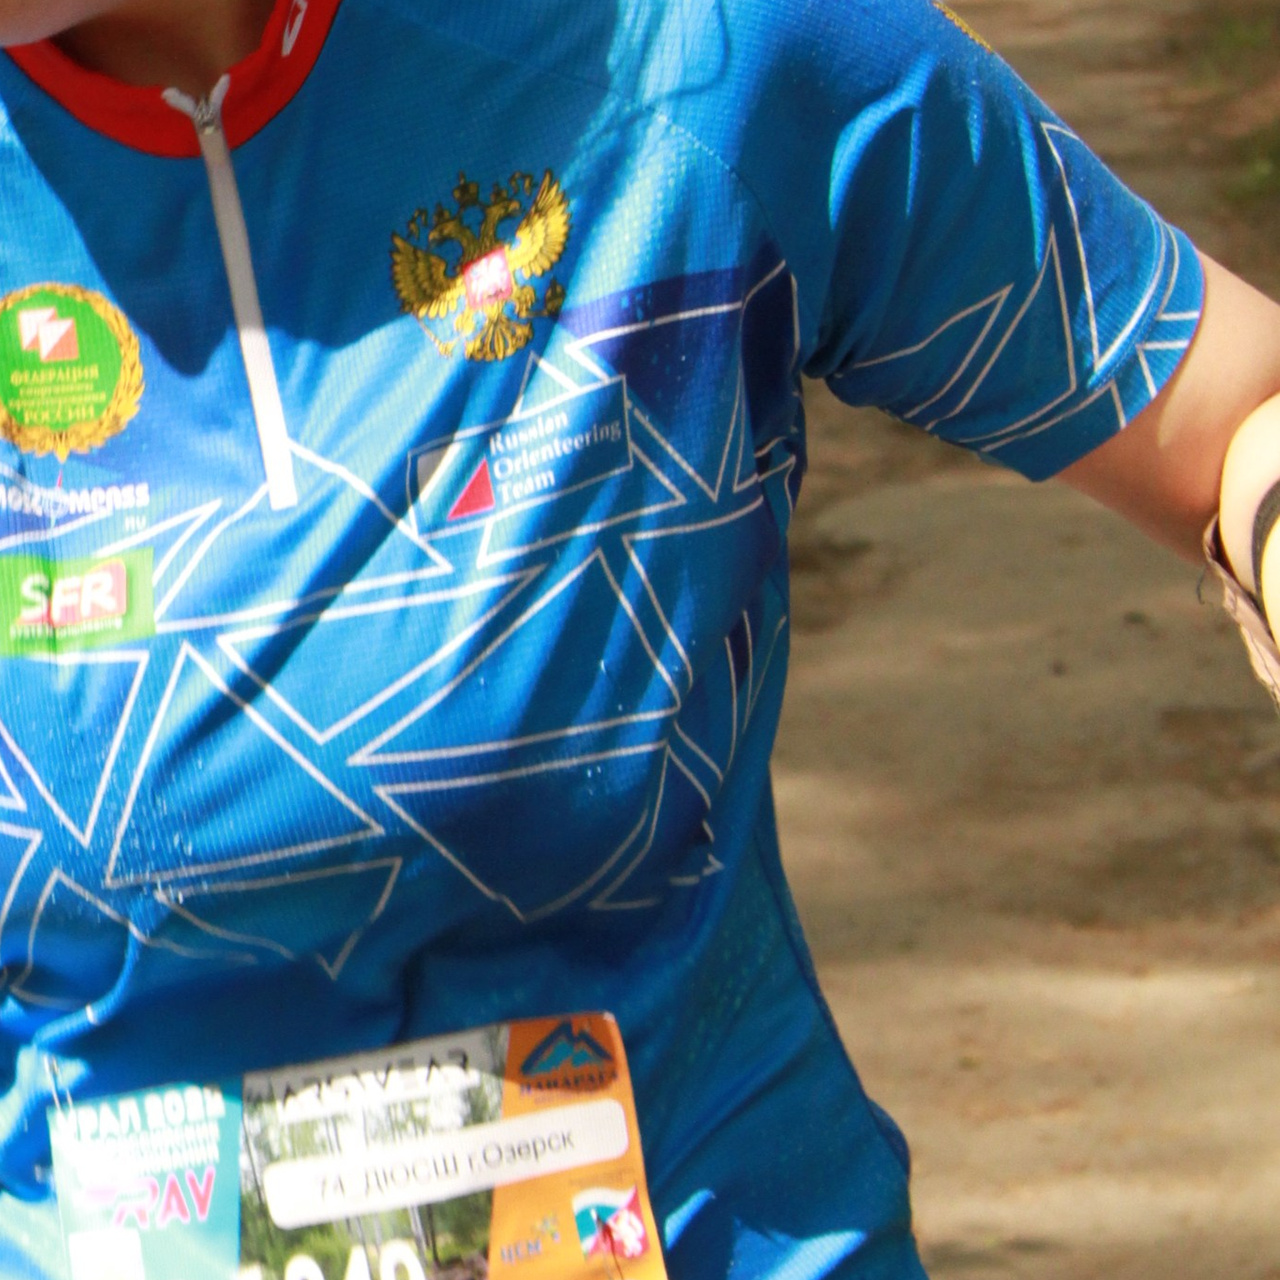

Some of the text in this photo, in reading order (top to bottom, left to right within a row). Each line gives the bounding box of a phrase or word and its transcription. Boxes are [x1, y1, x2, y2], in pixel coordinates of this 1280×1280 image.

[489, 411, 568, 455] Russian
[493, 421, 621, 480] Orienteering
[497, 470, 555, 504] Team
[21, 571, 117, 624] SFR
